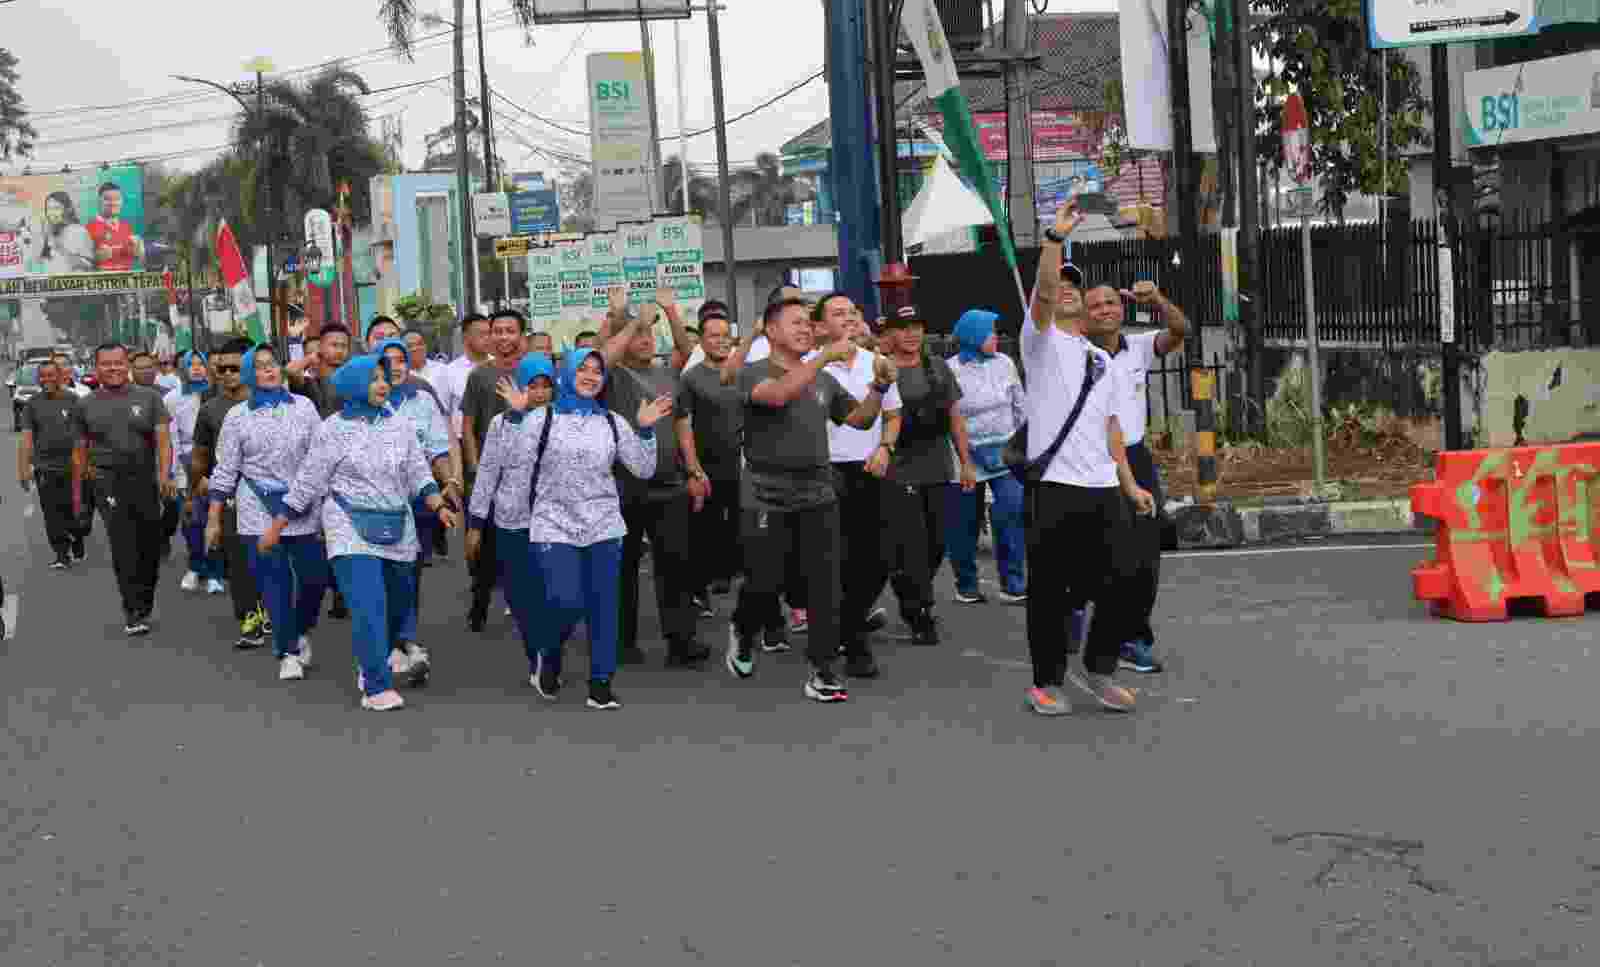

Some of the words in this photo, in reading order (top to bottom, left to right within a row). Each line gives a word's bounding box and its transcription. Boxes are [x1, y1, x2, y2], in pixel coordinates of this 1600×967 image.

[596, 81, 630, 101] BSI
[1480, 93, 1519, 130] BSI
[664, 264, 695, 275] EMAS
